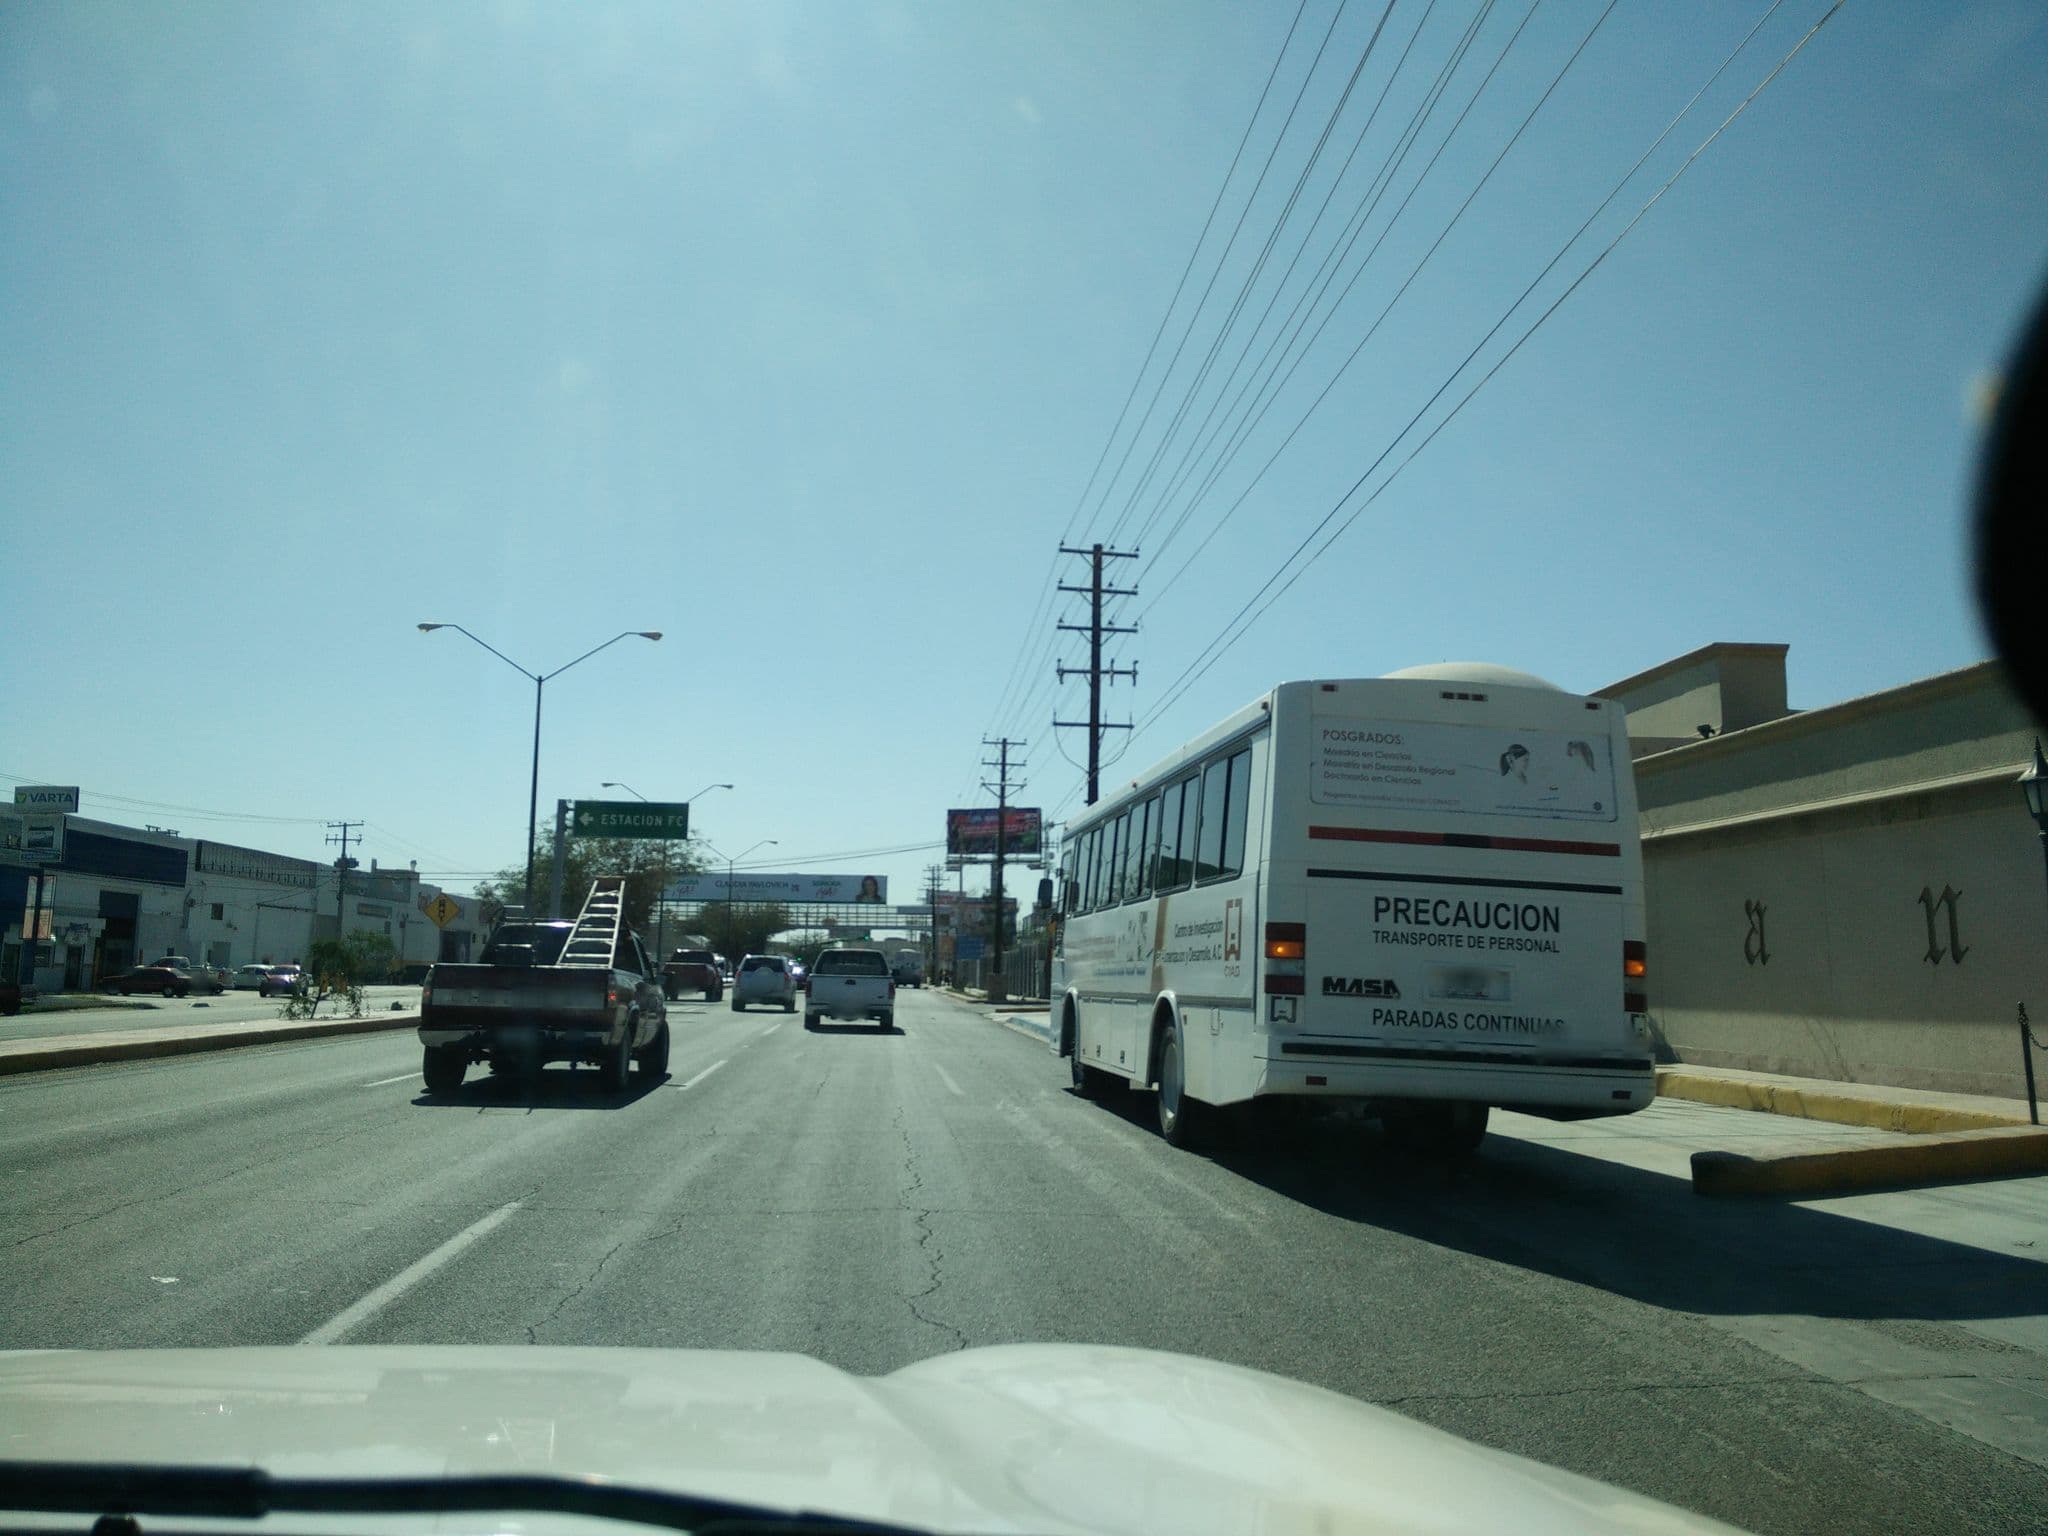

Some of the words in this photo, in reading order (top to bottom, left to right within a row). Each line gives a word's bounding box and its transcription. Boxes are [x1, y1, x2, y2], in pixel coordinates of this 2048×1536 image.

[30, 793, 73, 803] VARTA
[601, 814, 662, 826] ESTACION
[668, 815, 684, 827] FC
[1374, 896, 1560, 933] PRECAUCION
[1372, 930, 1462, 948] TRANSPORTE
[1467, 935, 1485, 949] DE
[1490, 937, 1560, 953] PERSONAL
[1322, 976, 1401, 998] MASA
[1372, 1008, 1458, 1030] PARADAS
